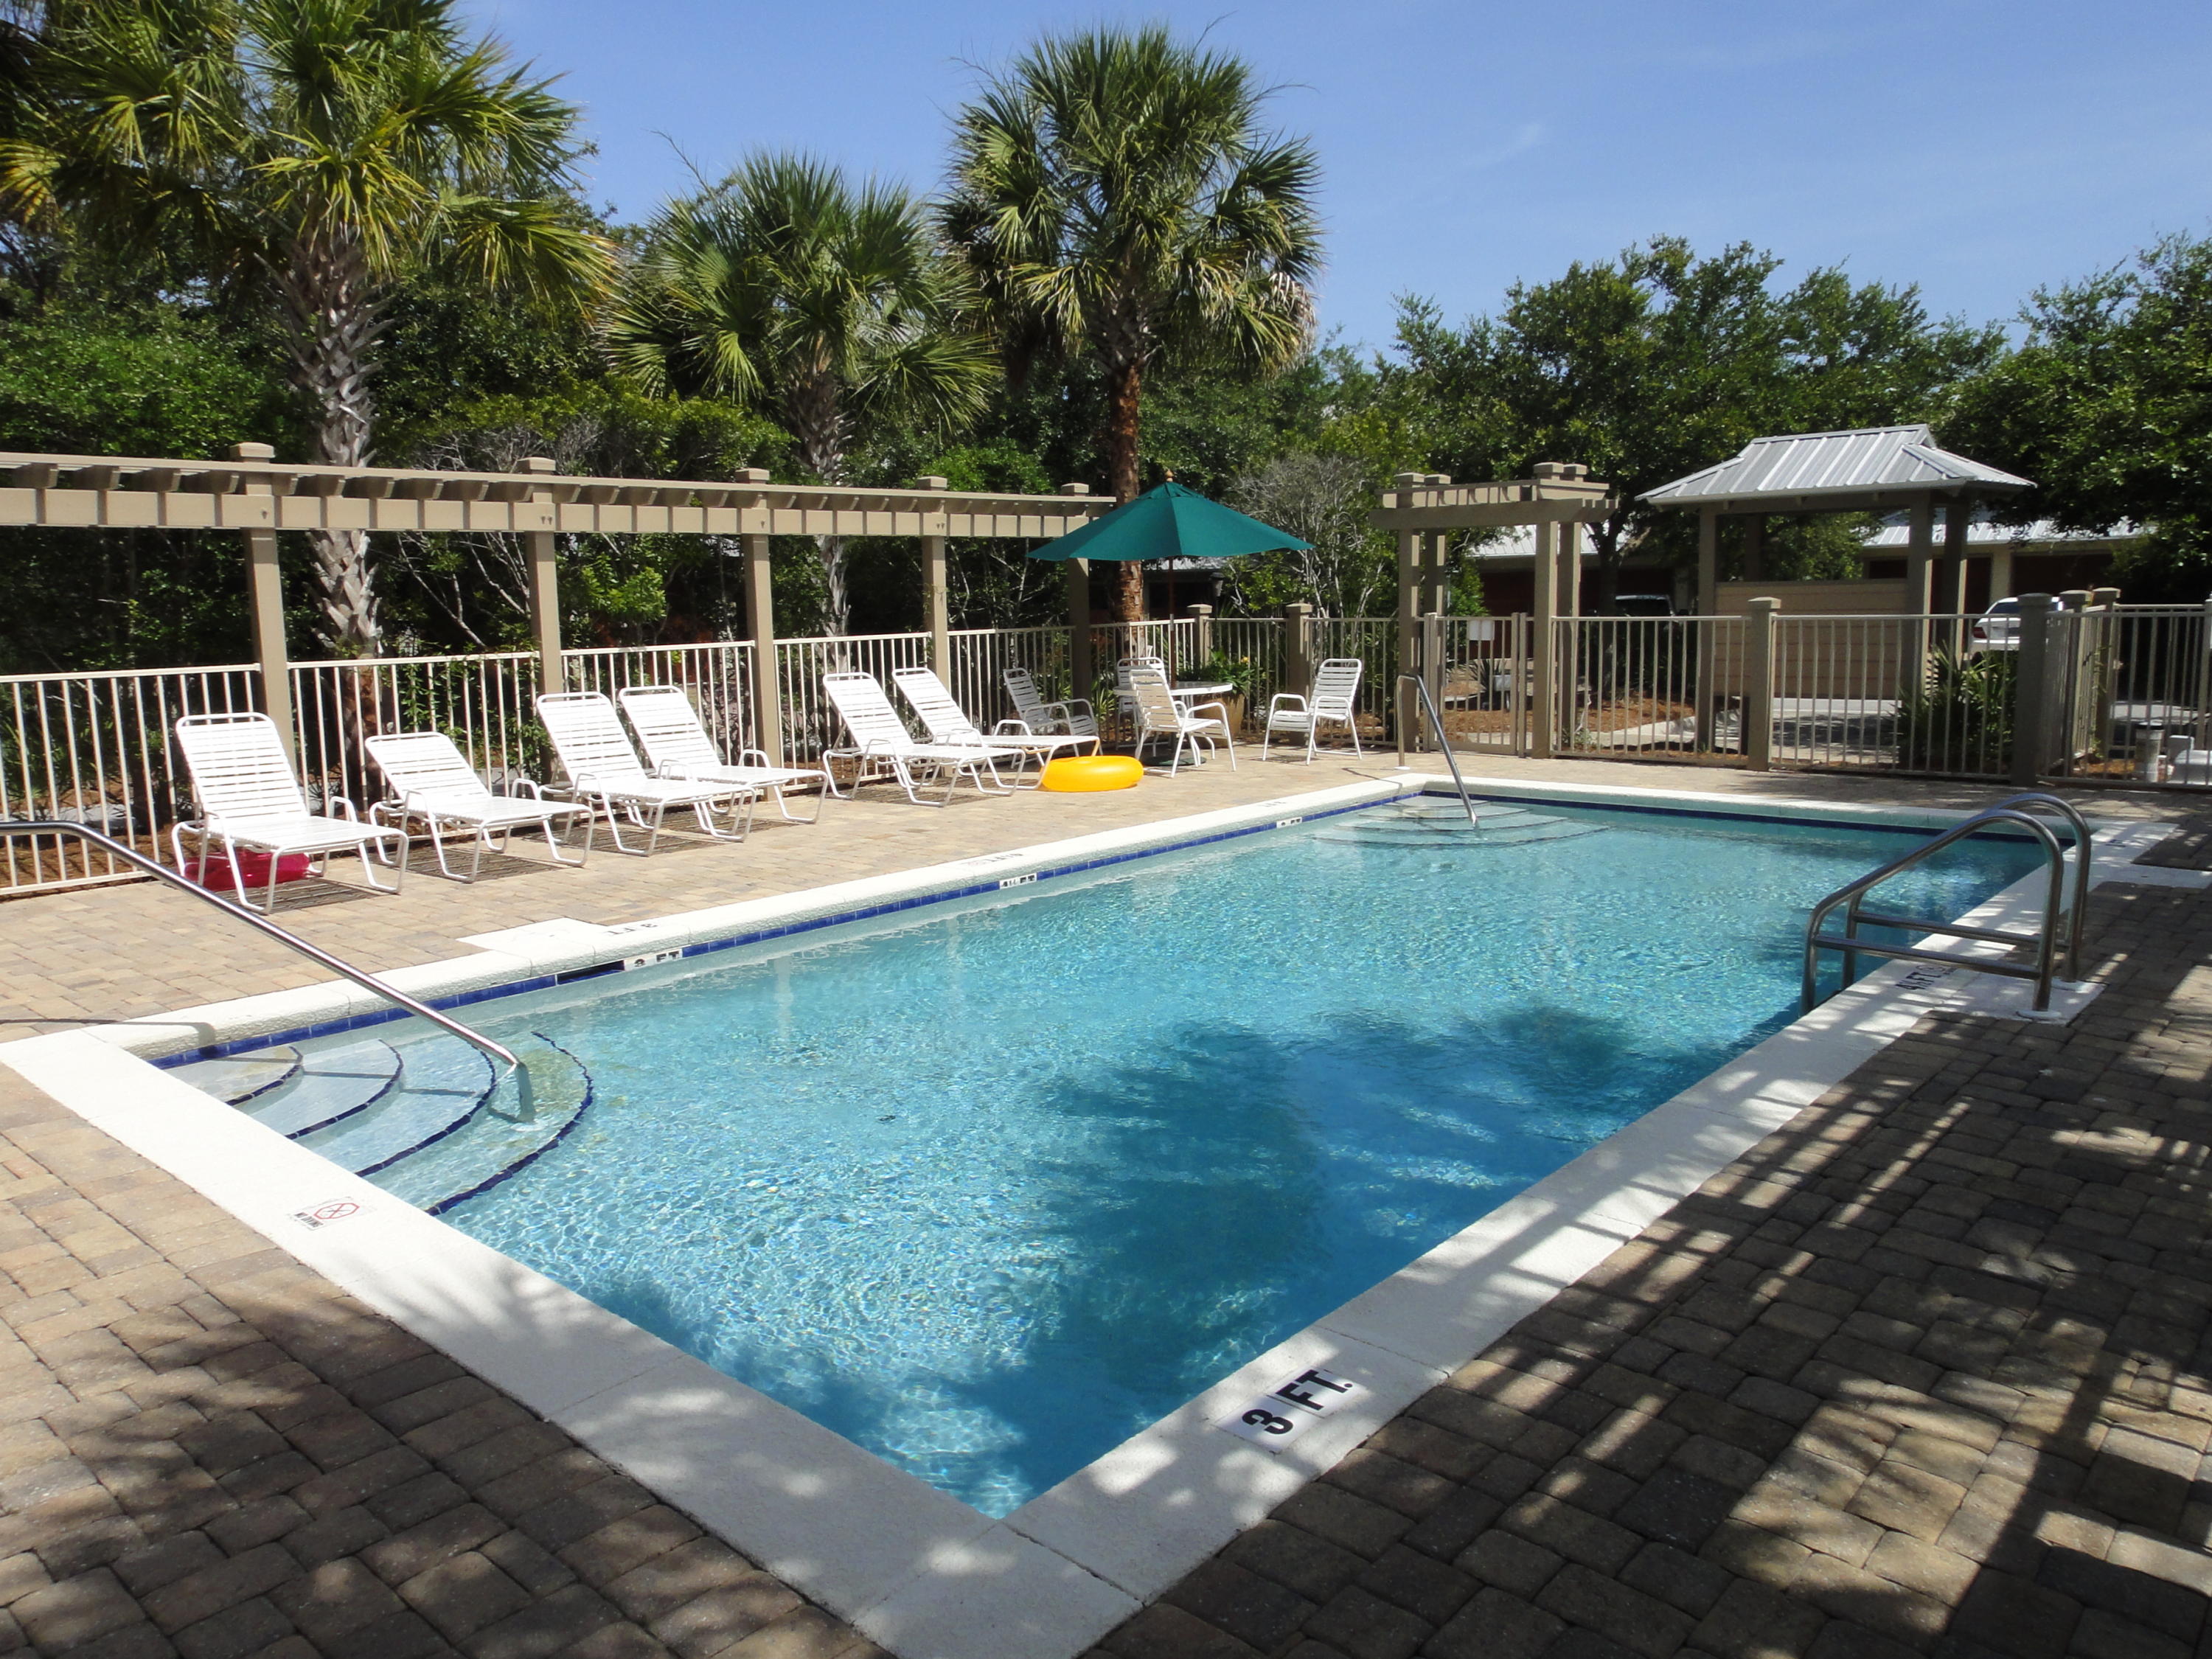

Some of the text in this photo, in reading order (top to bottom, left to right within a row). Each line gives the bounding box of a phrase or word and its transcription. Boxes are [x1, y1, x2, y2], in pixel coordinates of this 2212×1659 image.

[655, 950, 679, 962] FT
[1242, 1369, 1353, 1435] 3 FT.
